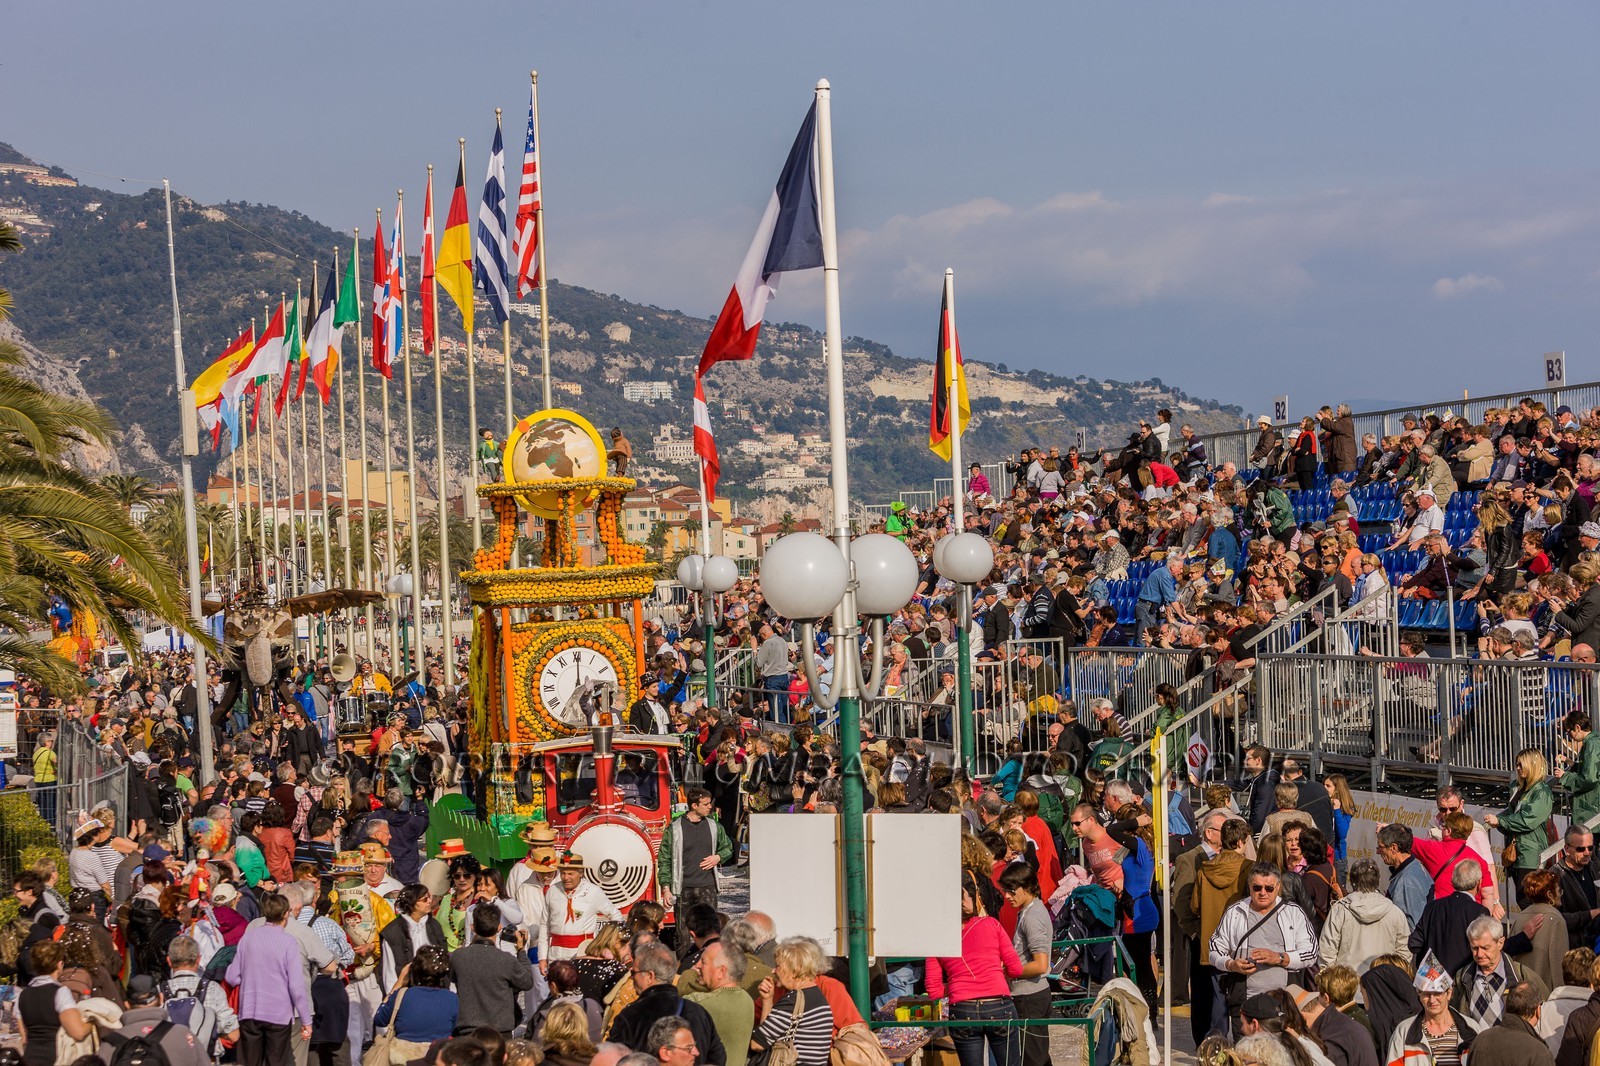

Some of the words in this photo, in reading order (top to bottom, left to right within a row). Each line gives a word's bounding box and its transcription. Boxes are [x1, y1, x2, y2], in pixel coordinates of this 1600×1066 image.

[1546, 359, 1562, 382] B3
[1275, 401, 1286, 420] B2
[1077, 431, 1085, 448] B1
[546, 669, 558, 678] X
[543, 684, 555, 692] IX
